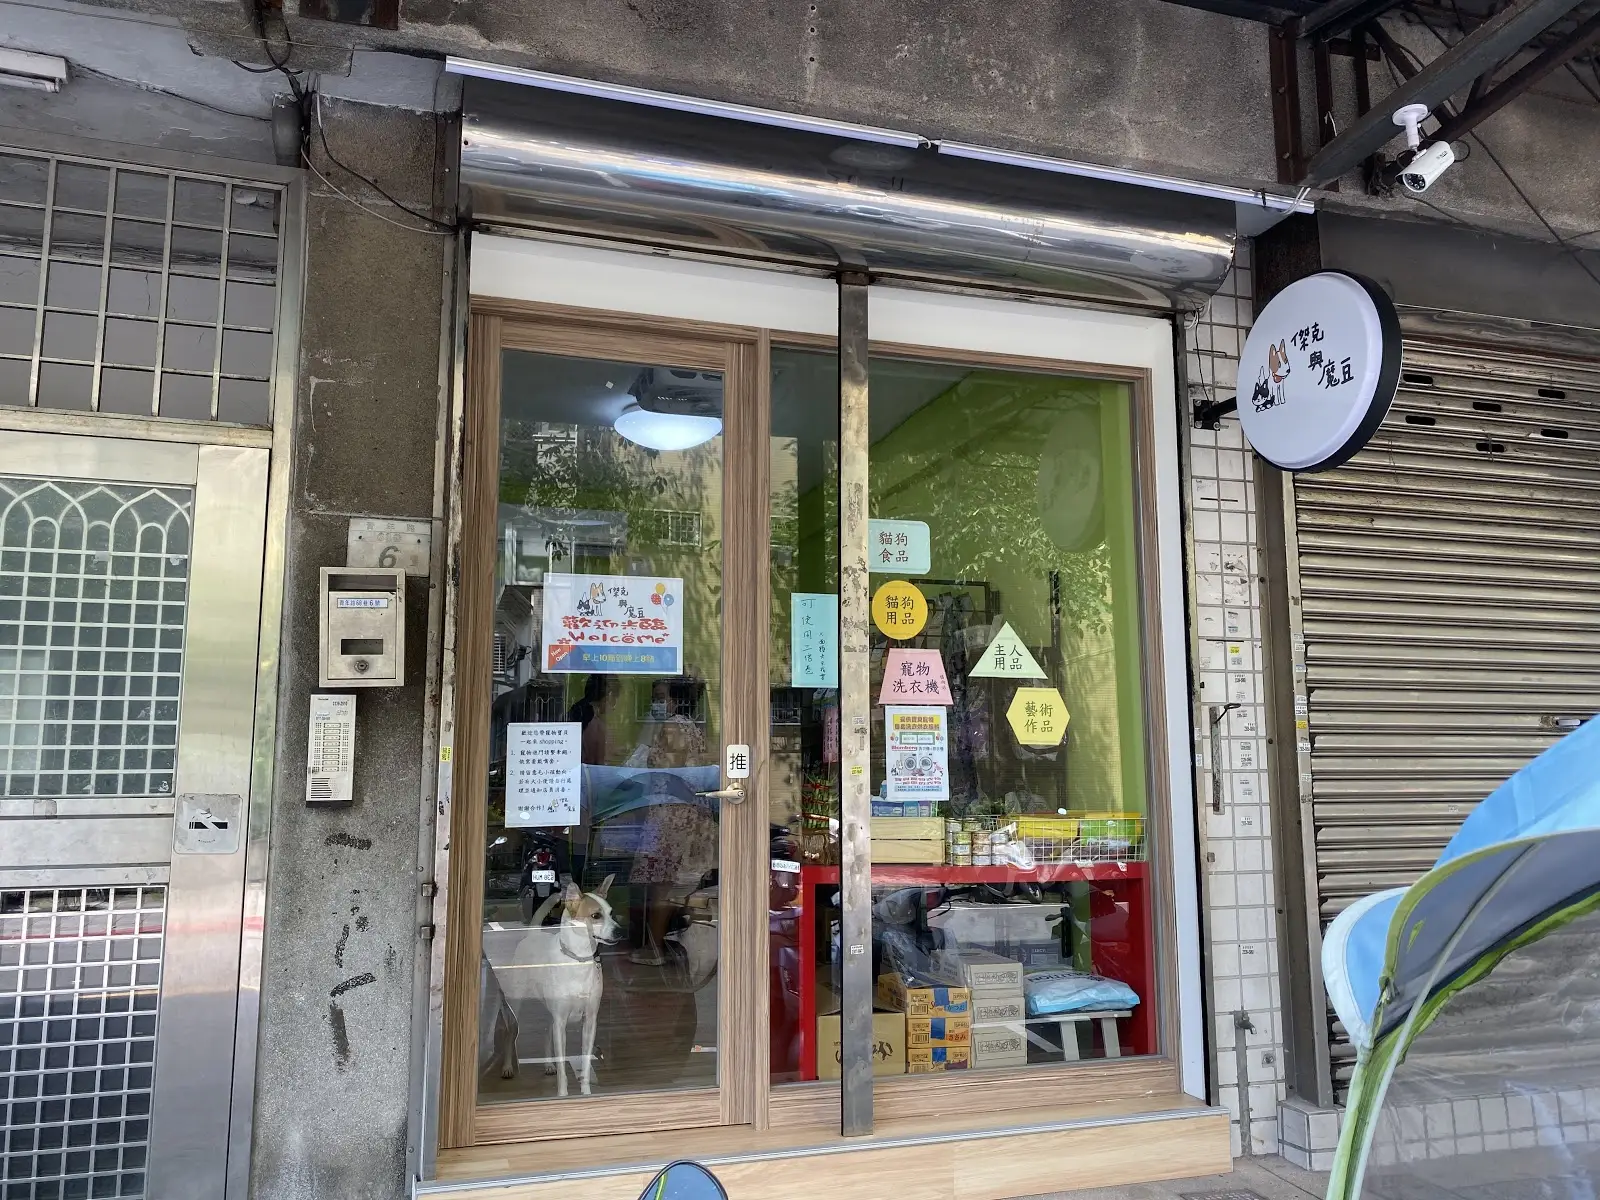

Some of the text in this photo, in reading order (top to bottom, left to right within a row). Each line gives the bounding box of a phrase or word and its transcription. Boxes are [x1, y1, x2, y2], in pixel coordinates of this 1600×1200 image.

[1290, 322, 1324, 351] 傑克
[1308, 350, 1323, 371] 與
[1317, 357, 1354, 389] 魔豆
[879, 531, 908, 547] 貓狗
[379, 545, 400, 567] 6
[879, 547, 909, 563] 食品
[607, 586, 629, 598] 傑克
[885, 595, 914, 611] 貓狗
[624, 605, 645, 618] 魔豆
[885, 611, 915, 625] 用品
[562, 615, 668, 631] 歡迎光臨
[568, 631, 666, 644] Welcome
[994, 644, 1023, 657] 主人
[900, 661, 930, 677] 寵物
[994, 656, 1023, 670] 用品
[892, 679, 940, 695] 洗衣機
[1024, 701, 1053, 717] 藝術
[1024, 719, 1053, 734] 作品
[729, 752, 747, 770] 推
